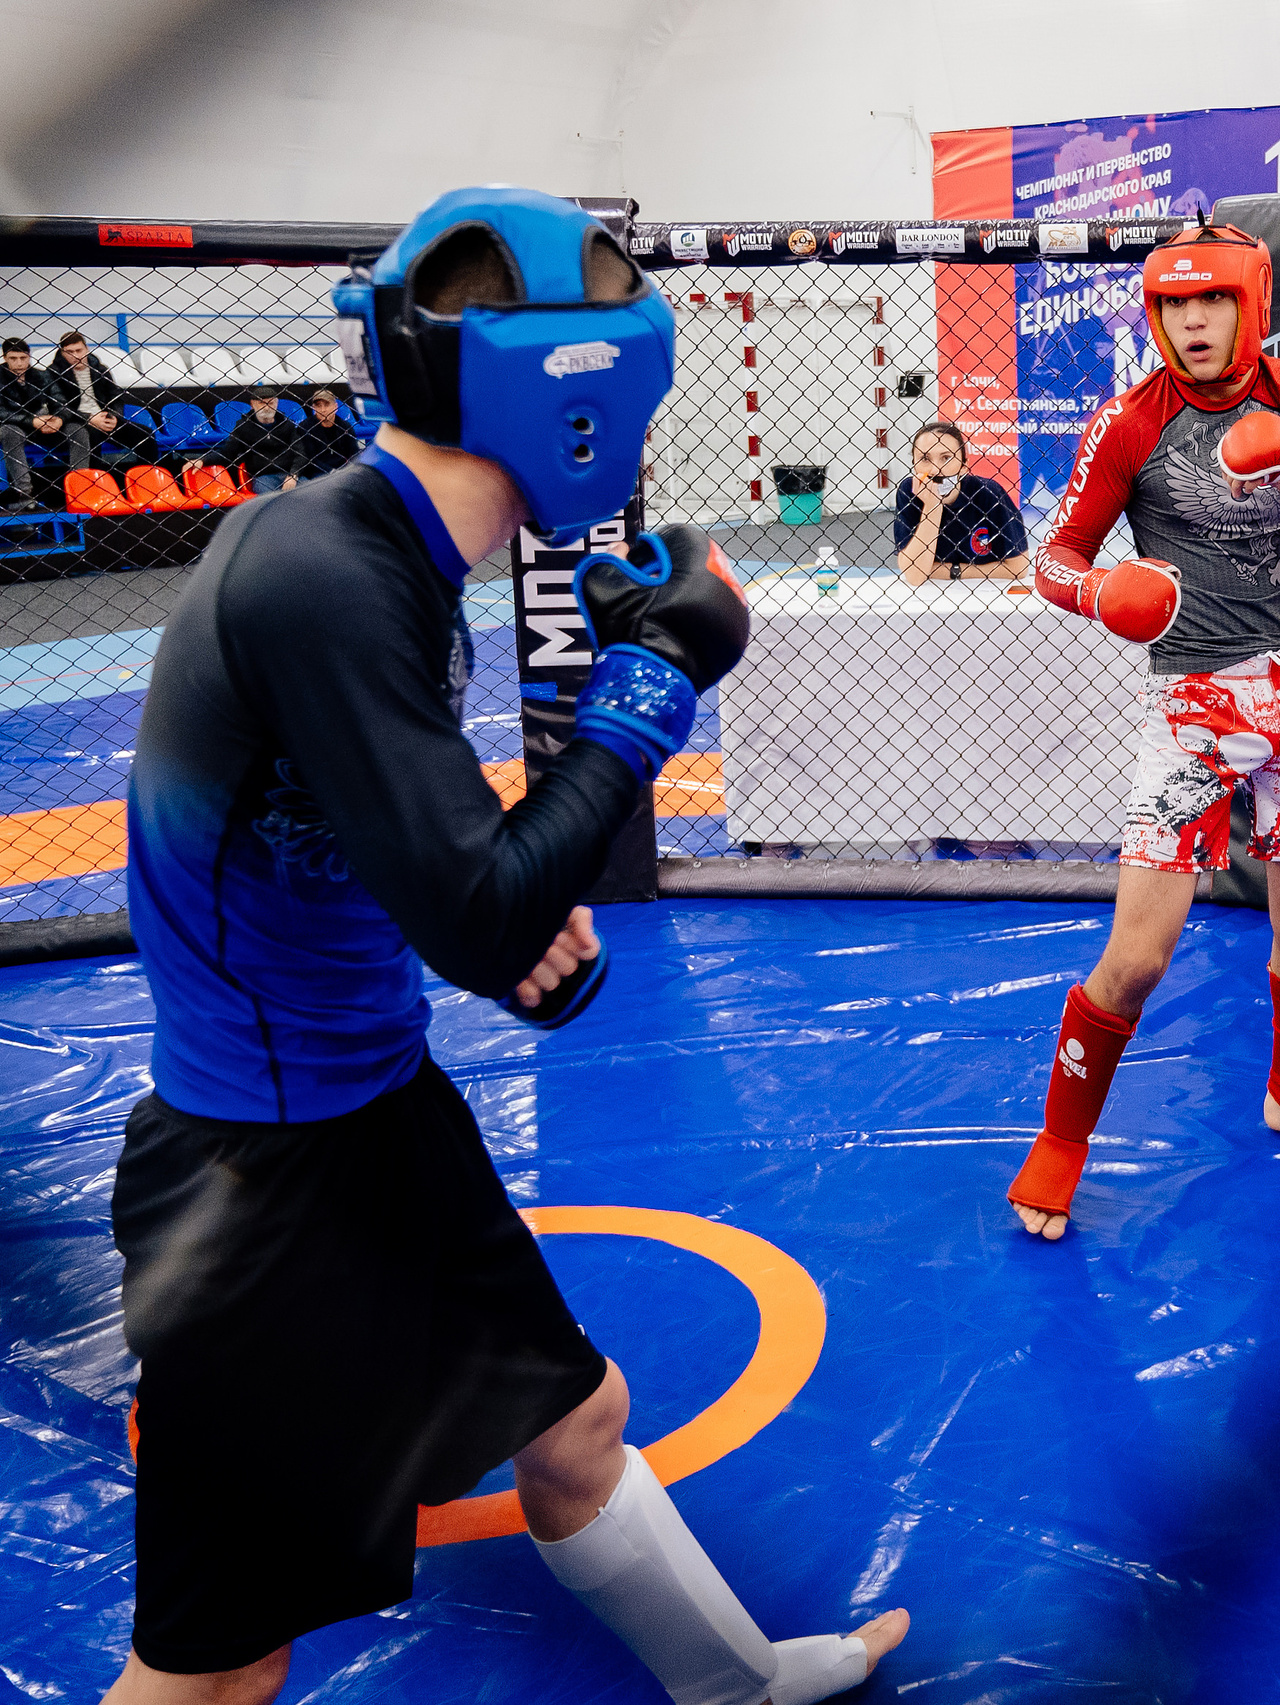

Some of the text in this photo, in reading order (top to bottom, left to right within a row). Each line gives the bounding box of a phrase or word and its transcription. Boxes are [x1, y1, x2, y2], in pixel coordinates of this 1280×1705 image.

[1016, 143, 1172, 201] ЧЕМПИОНАТ И ПЕРВЕНСТВО
[1034, 180, 1139, 219] КРАСНОДАРСКОГО
[1140, 169, 1172, 190] КРАЯ
[126, 230, 186, 243] SPARTA
[740, 232, 774, 245] MOTIV
[846, 231, 880, 243] MOTIV
[901, 233, 960, 242] BAR LONDON
[996, 229, 1031, 242] MOTIV
[1123, 226, 1158, 239] MOTIV
[846, 242, 879, 250] WARRIORS
[997, 239, 1029, 248] WARRIORS
[1123, 236, 1156, 246] WARRIORS
[954, 419, 1038, 437] портивный
[1072, 400, 1124, 493] UNION
